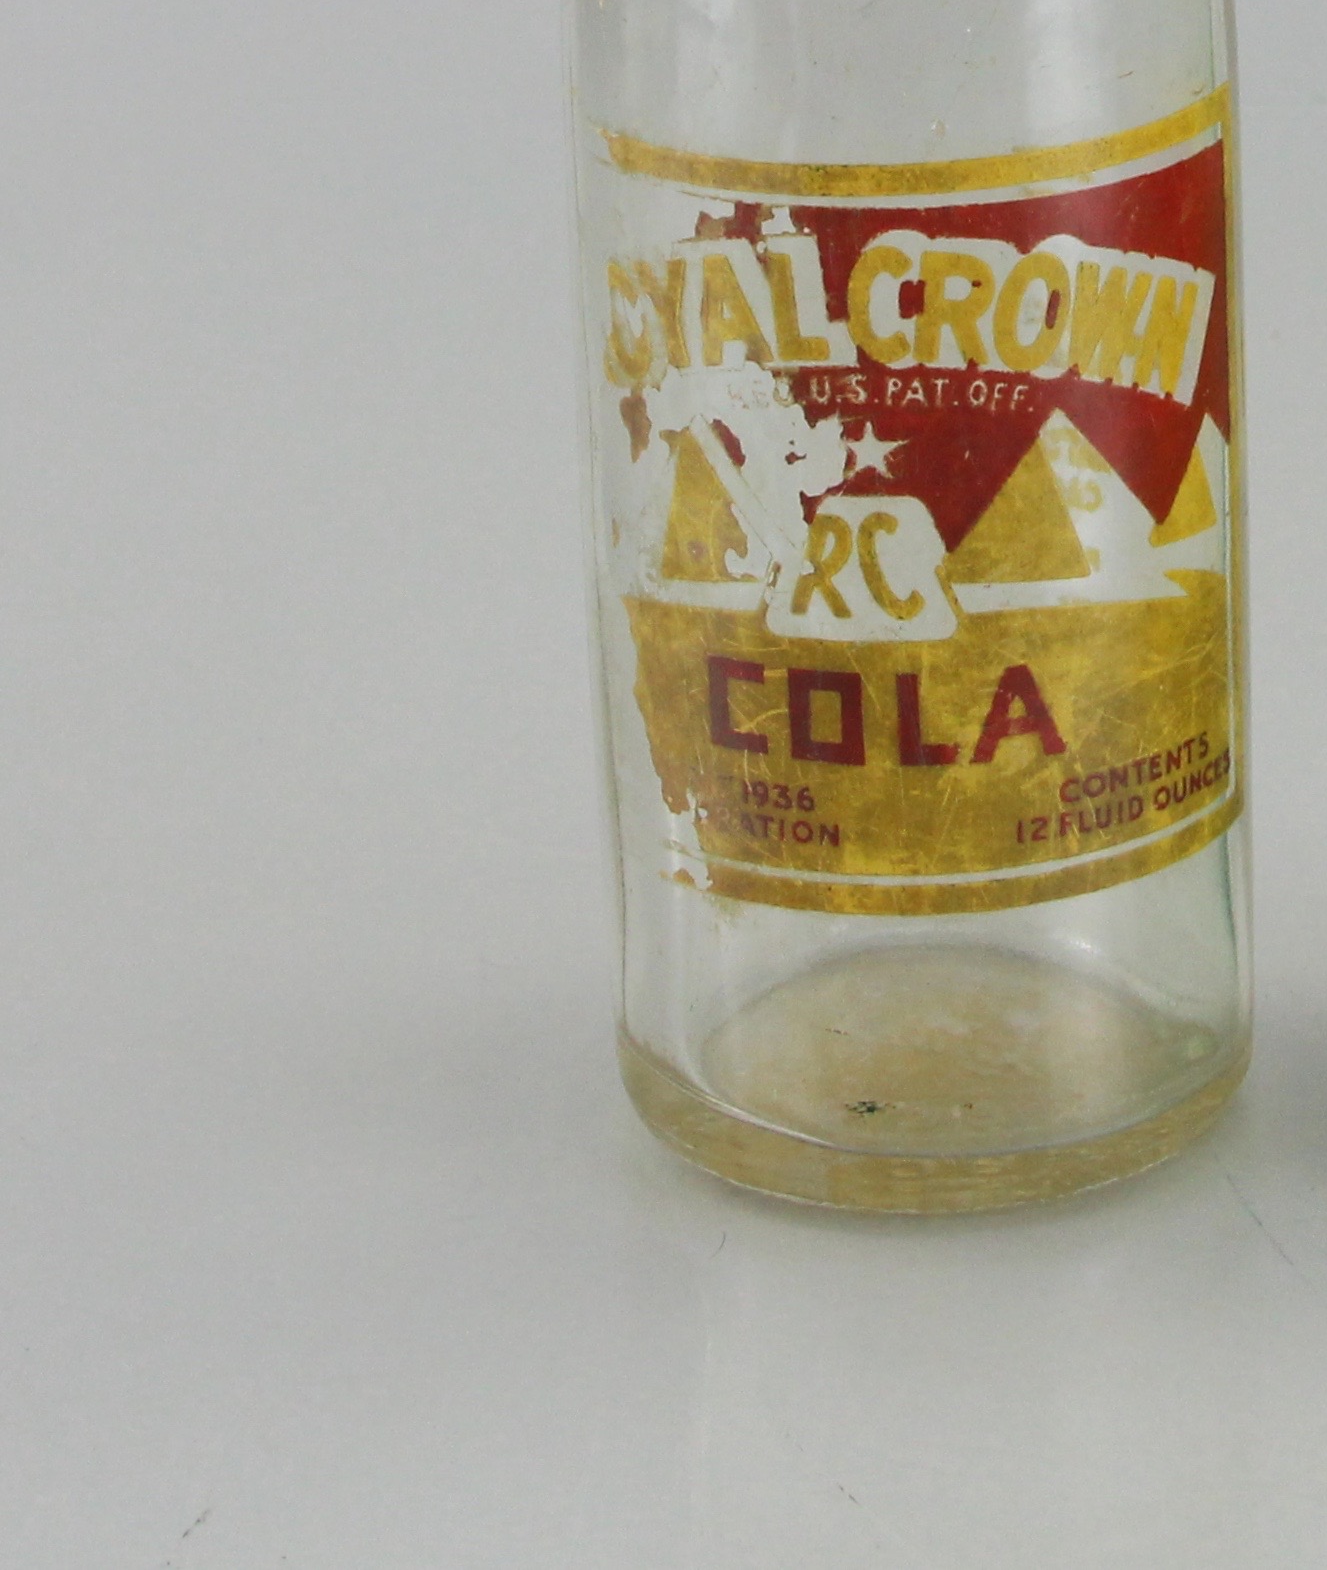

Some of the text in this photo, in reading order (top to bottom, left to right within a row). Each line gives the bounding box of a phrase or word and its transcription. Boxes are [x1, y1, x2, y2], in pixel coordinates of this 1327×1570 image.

[847, 244, 1200, 394] CROWN
[790, 512, 926, 620] RC
[706, 654, 1068, 766] COLA
[742, 781, 815, 811] 1936
[1060, 731, 1210, 803] CONTENTS
[1016, 817, 1048, 844] 12
[1058, 795, 1144, 837] FLUID
